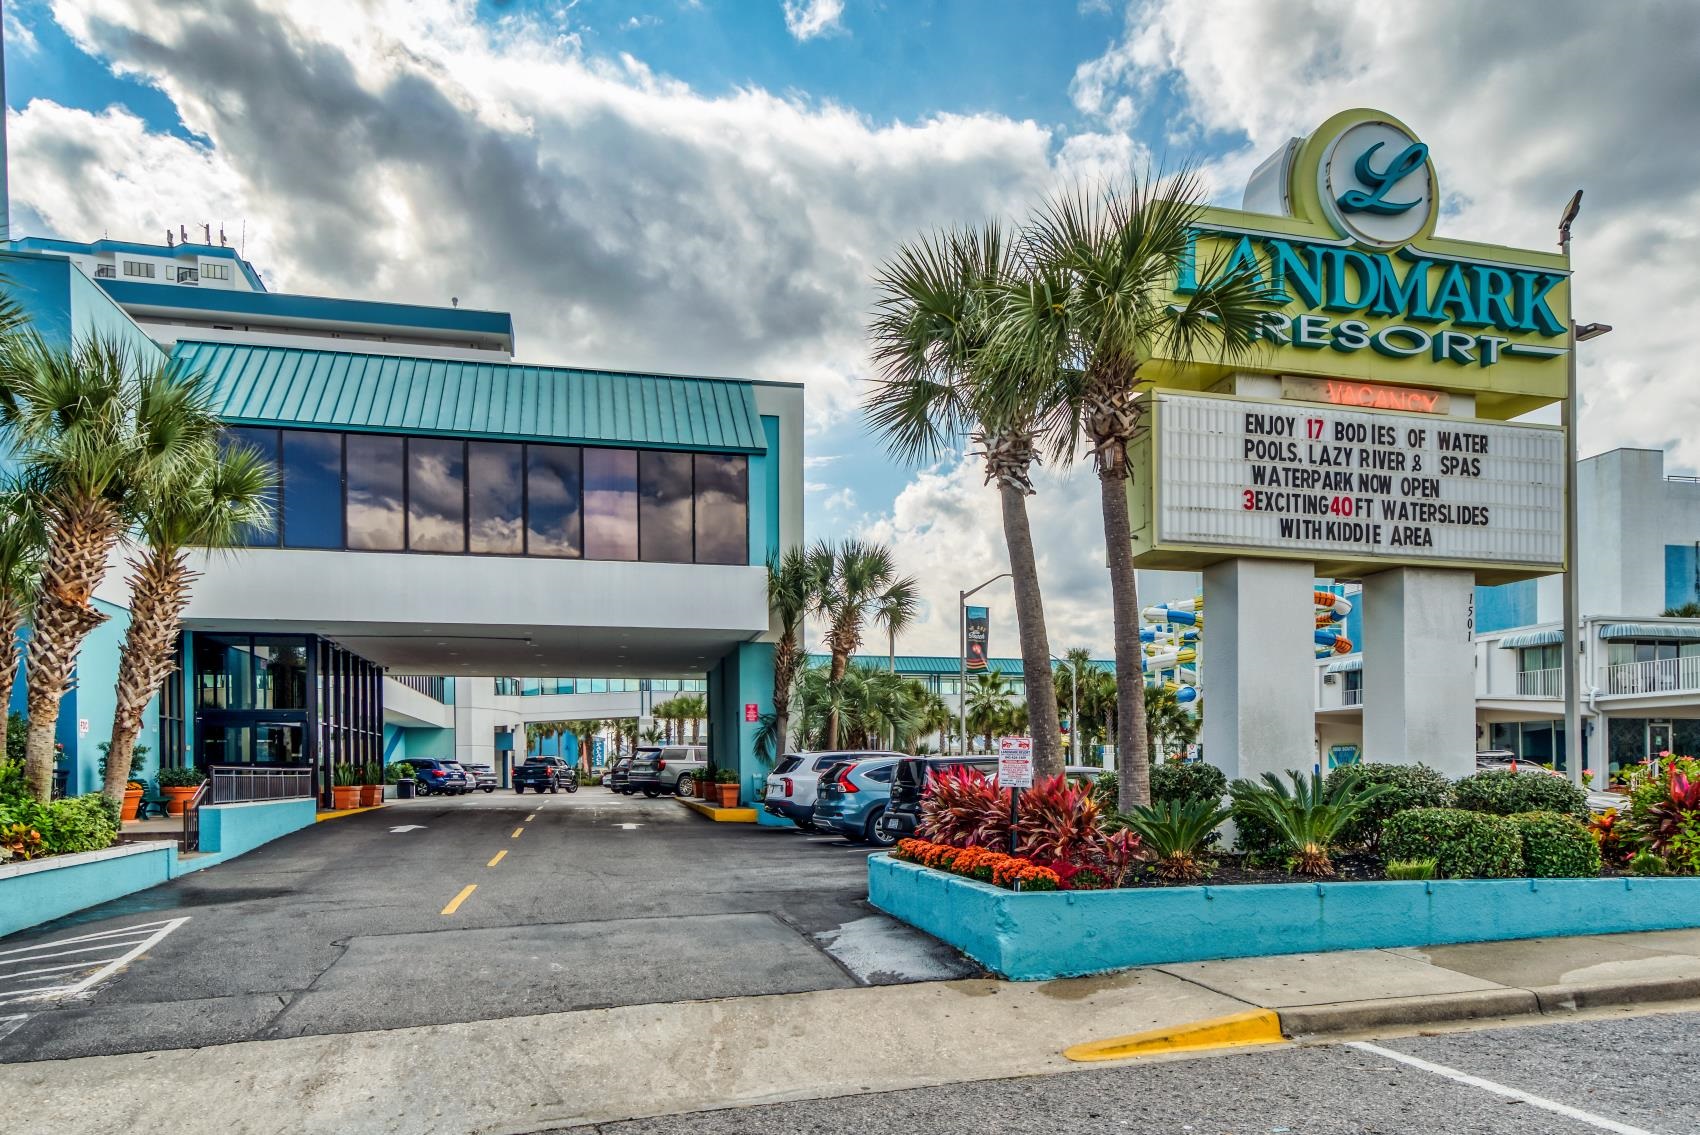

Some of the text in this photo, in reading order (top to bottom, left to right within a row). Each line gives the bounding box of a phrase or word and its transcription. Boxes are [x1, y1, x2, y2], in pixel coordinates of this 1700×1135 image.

[1337, 141, 1429, 216] L
[1174, 228, 1568, 336] LANDMARK
[1247, 308, 1509, 367] RESORT
[1327, 380, 1440, 412] VACANCY
[1245, 413, 1489, 454] ENJOY 17 BODIES OF WATER
[1308, 444, 1353, 467] LAZY
[1359, 448, 1406, 471] RIVER
[1411, 454, 1422, 472] &
[1440, 455, 1481, 477] SPAS
[1251, 464, 1440, 499] WATERPARK NOW OPEN
[1381, 499, 1489, 526] WATERSLIDES
[1280, 517, 1433, 547] WITH KIDDIE AREA
